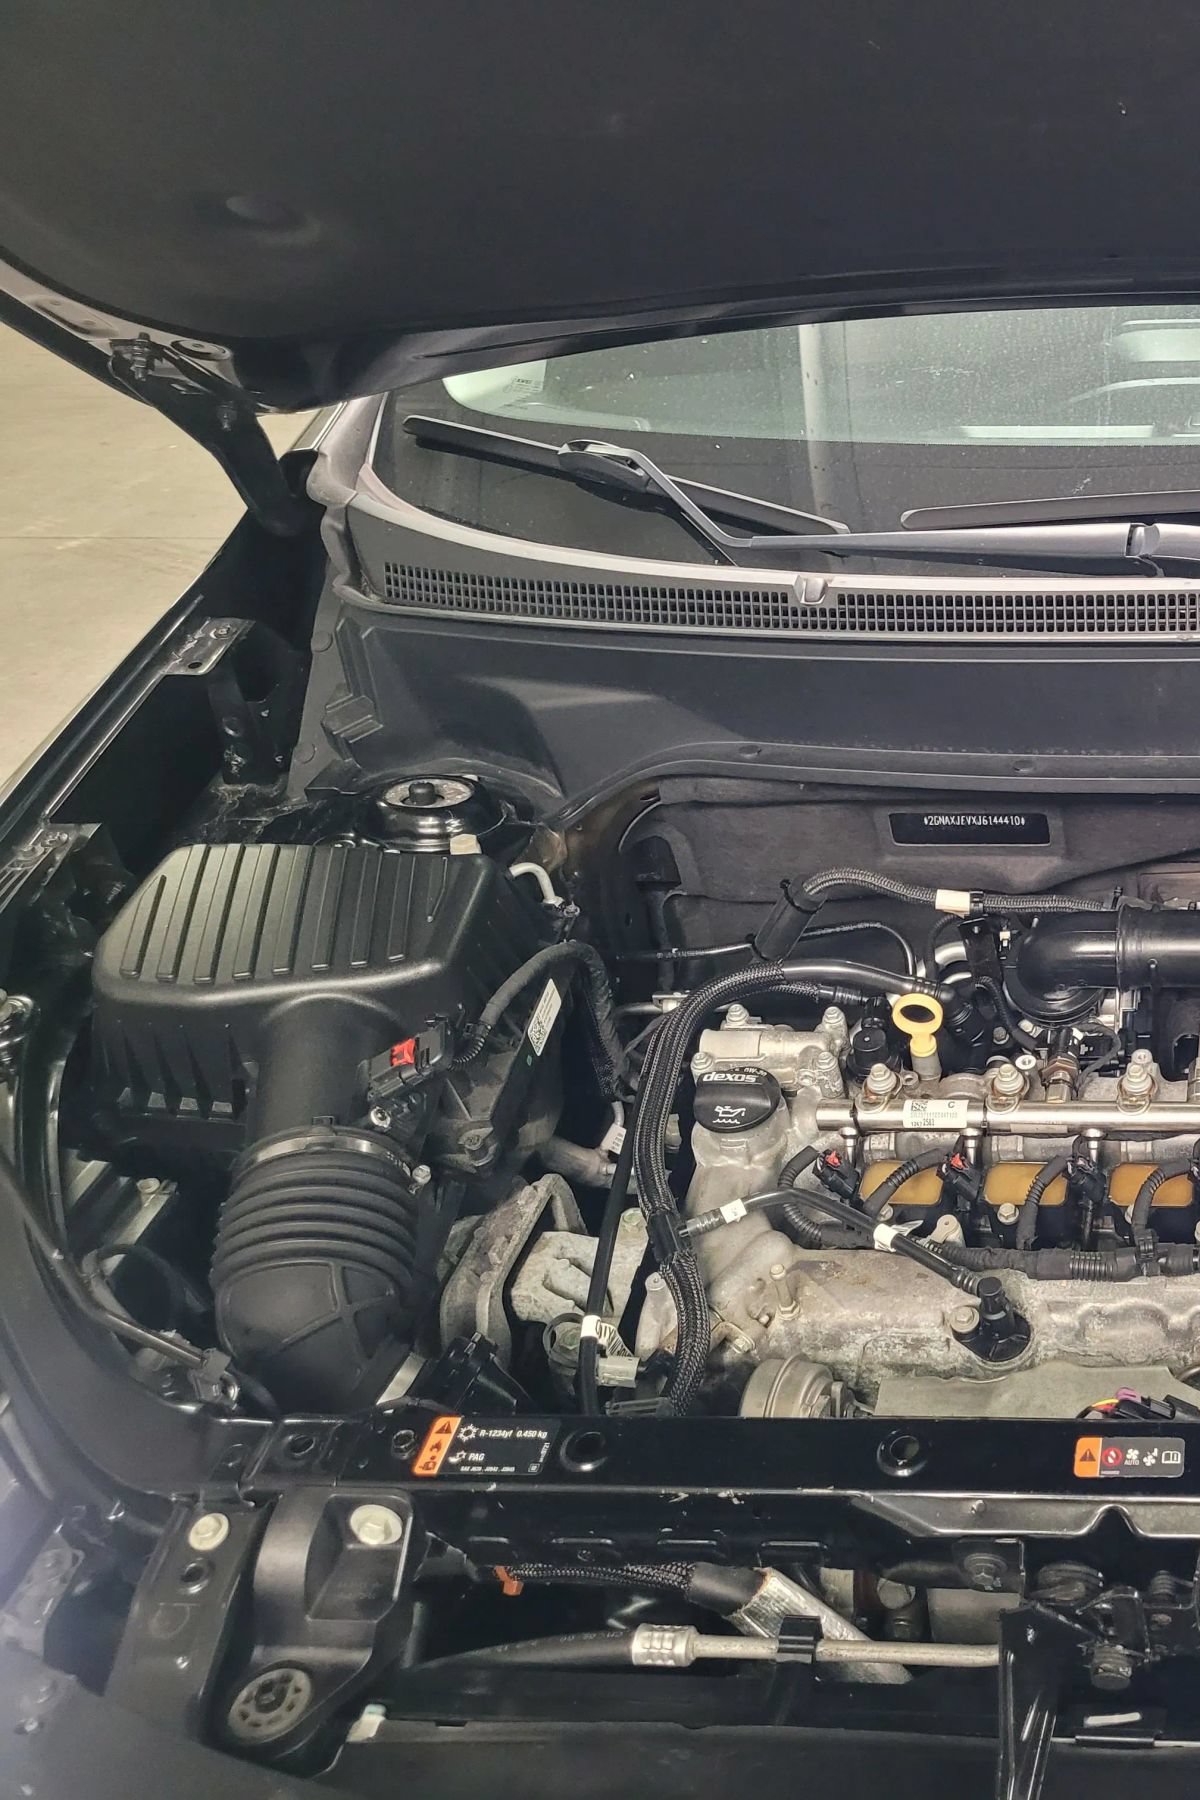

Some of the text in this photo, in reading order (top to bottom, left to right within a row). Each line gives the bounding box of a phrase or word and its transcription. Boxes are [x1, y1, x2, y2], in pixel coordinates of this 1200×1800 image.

[702, 1072, 759, 1083] dexos
[479, 1429, 513, 1438] R-1234yf
[537, 1430, 548, 1439] kg
[468, 1452, 485, 1461] PAG
